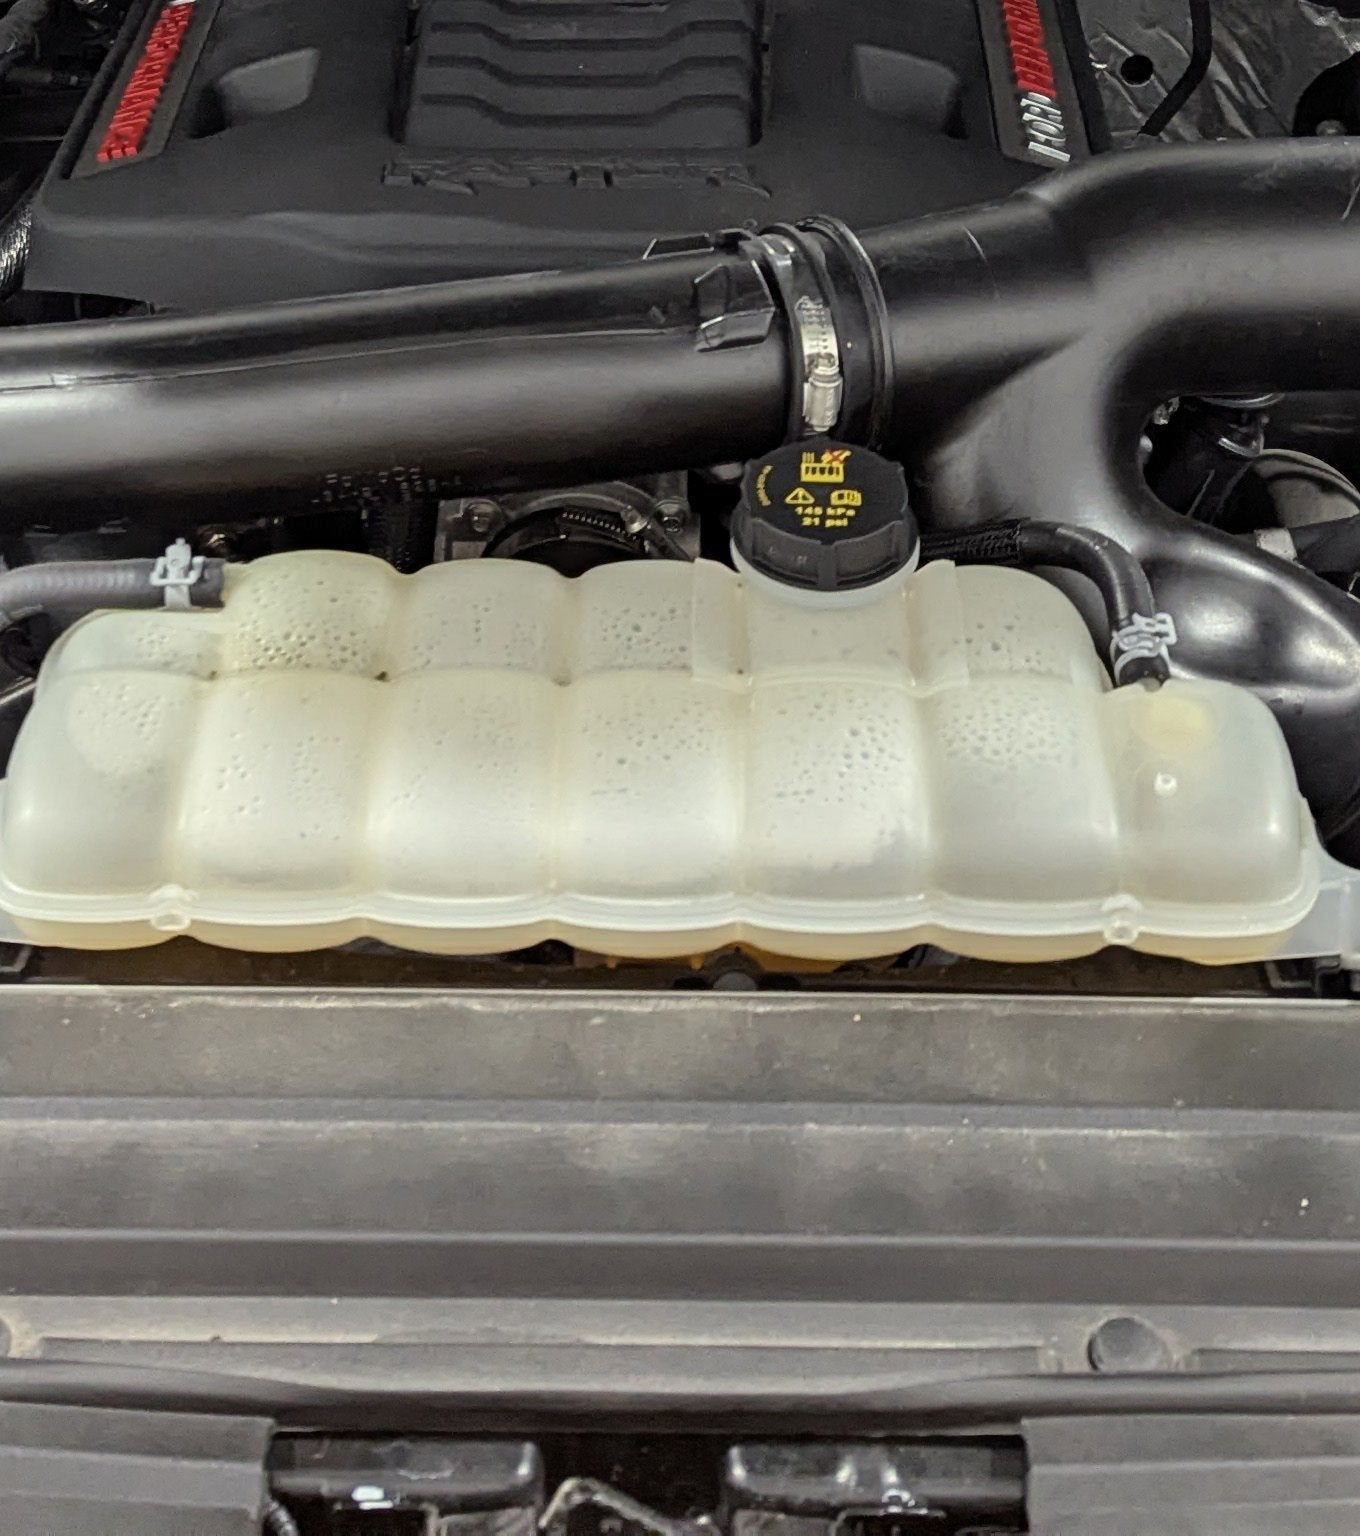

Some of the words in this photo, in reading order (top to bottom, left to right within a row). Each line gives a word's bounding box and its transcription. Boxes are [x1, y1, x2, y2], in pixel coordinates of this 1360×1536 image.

[794, 506, 823, 516] 145
[826, 506, 856, 517] kPa
[801, 517, 821, 527] 21
[825, 517, 849, 528] psi
